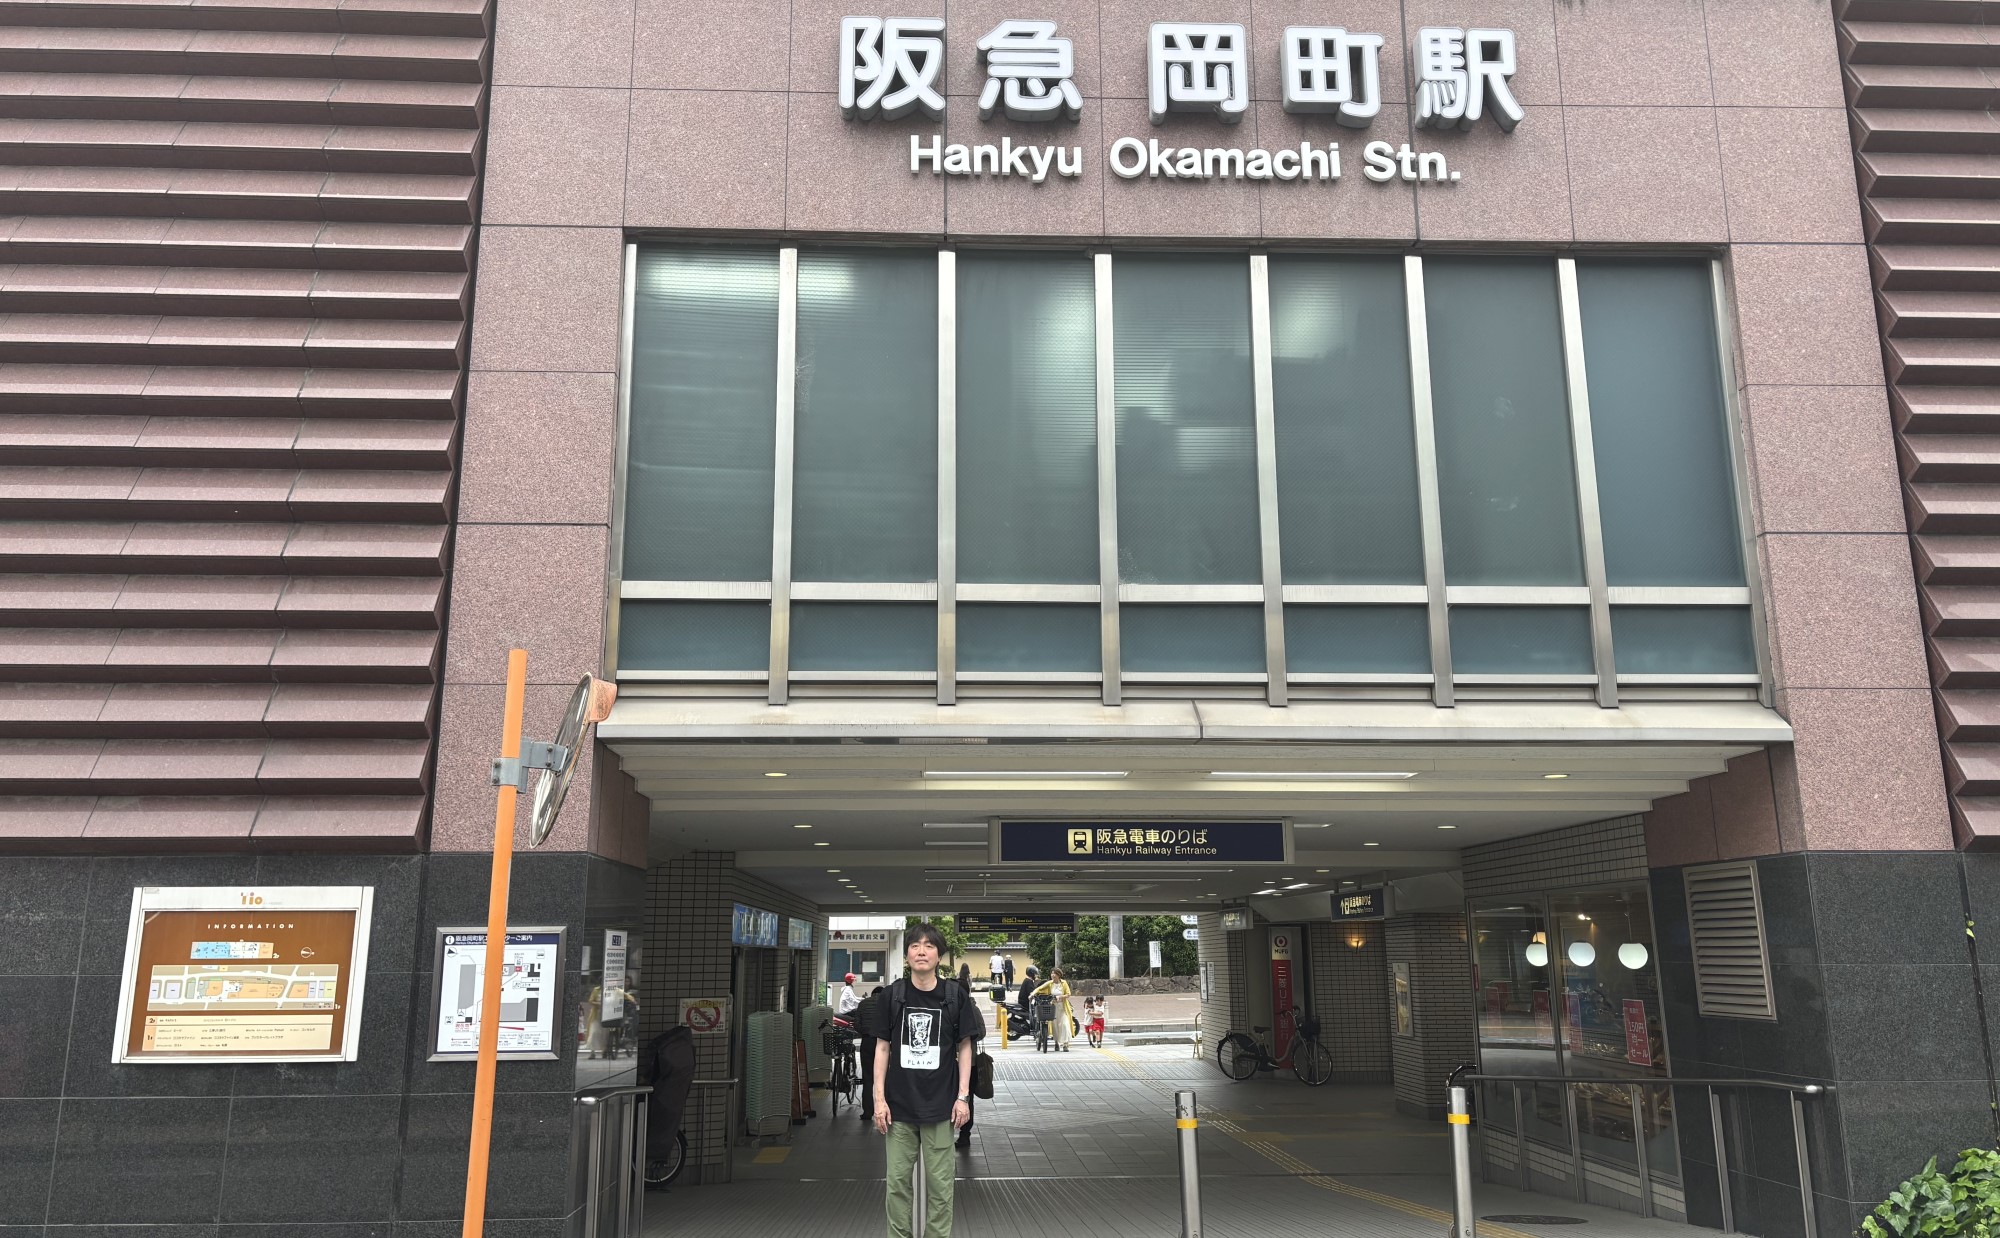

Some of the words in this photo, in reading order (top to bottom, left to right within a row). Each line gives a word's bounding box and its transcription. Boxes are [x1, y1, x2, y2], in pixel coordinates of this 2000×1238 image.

[839, 16, 1083, 122] 阪急
[1147, 21, 1526, 131] 岡町駅
[910, 134, 1082, 183] Hankyu
[1110, 137, 1342, 180] Okamachi
[1363, 140, 1460, 182] Stn.
[1096, 828, 1208, 844] 阪急電車のりば
[1097, 846, 1132, 856] Hankyu
[1136, 846, 1172, 856] Railway
[1175, 846, 1217, 855] Entrance
[1628, 1021, 1644, 1034] 150円
[1631, 1047, 1648, 1058] セール
